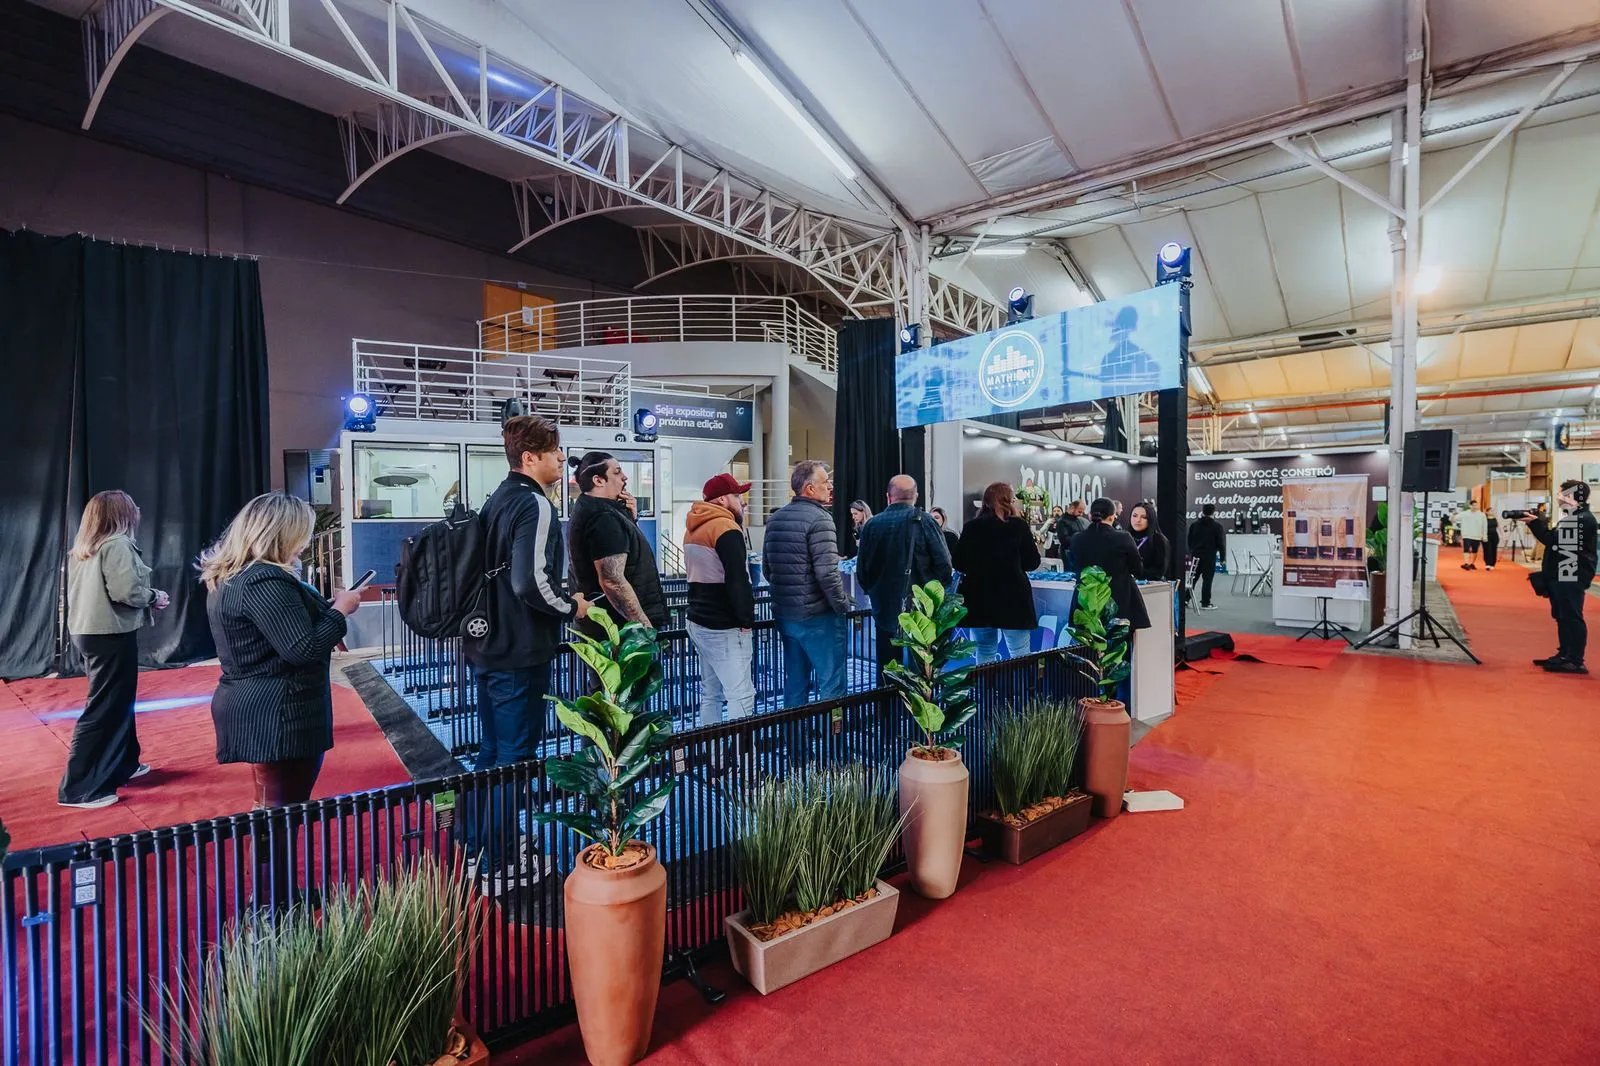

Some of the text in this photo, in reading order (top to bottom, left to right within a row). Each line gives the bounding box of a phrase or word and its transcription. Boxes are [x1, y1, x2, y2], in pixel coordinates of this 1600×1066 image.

[655, 405, 674, 416] Seja
[676, 407, 716, 418] expositor
[717, 411, 727, 419] na
[659, 416, 724, 430] próxima edição
[1194, 470, 1248, 480] ENQUANTO
[1250, 468, 1279, 478] VOCÊ
[1212, 479, 1257, 489] GRANDES
[1195, 494, 1217, 505] nós
